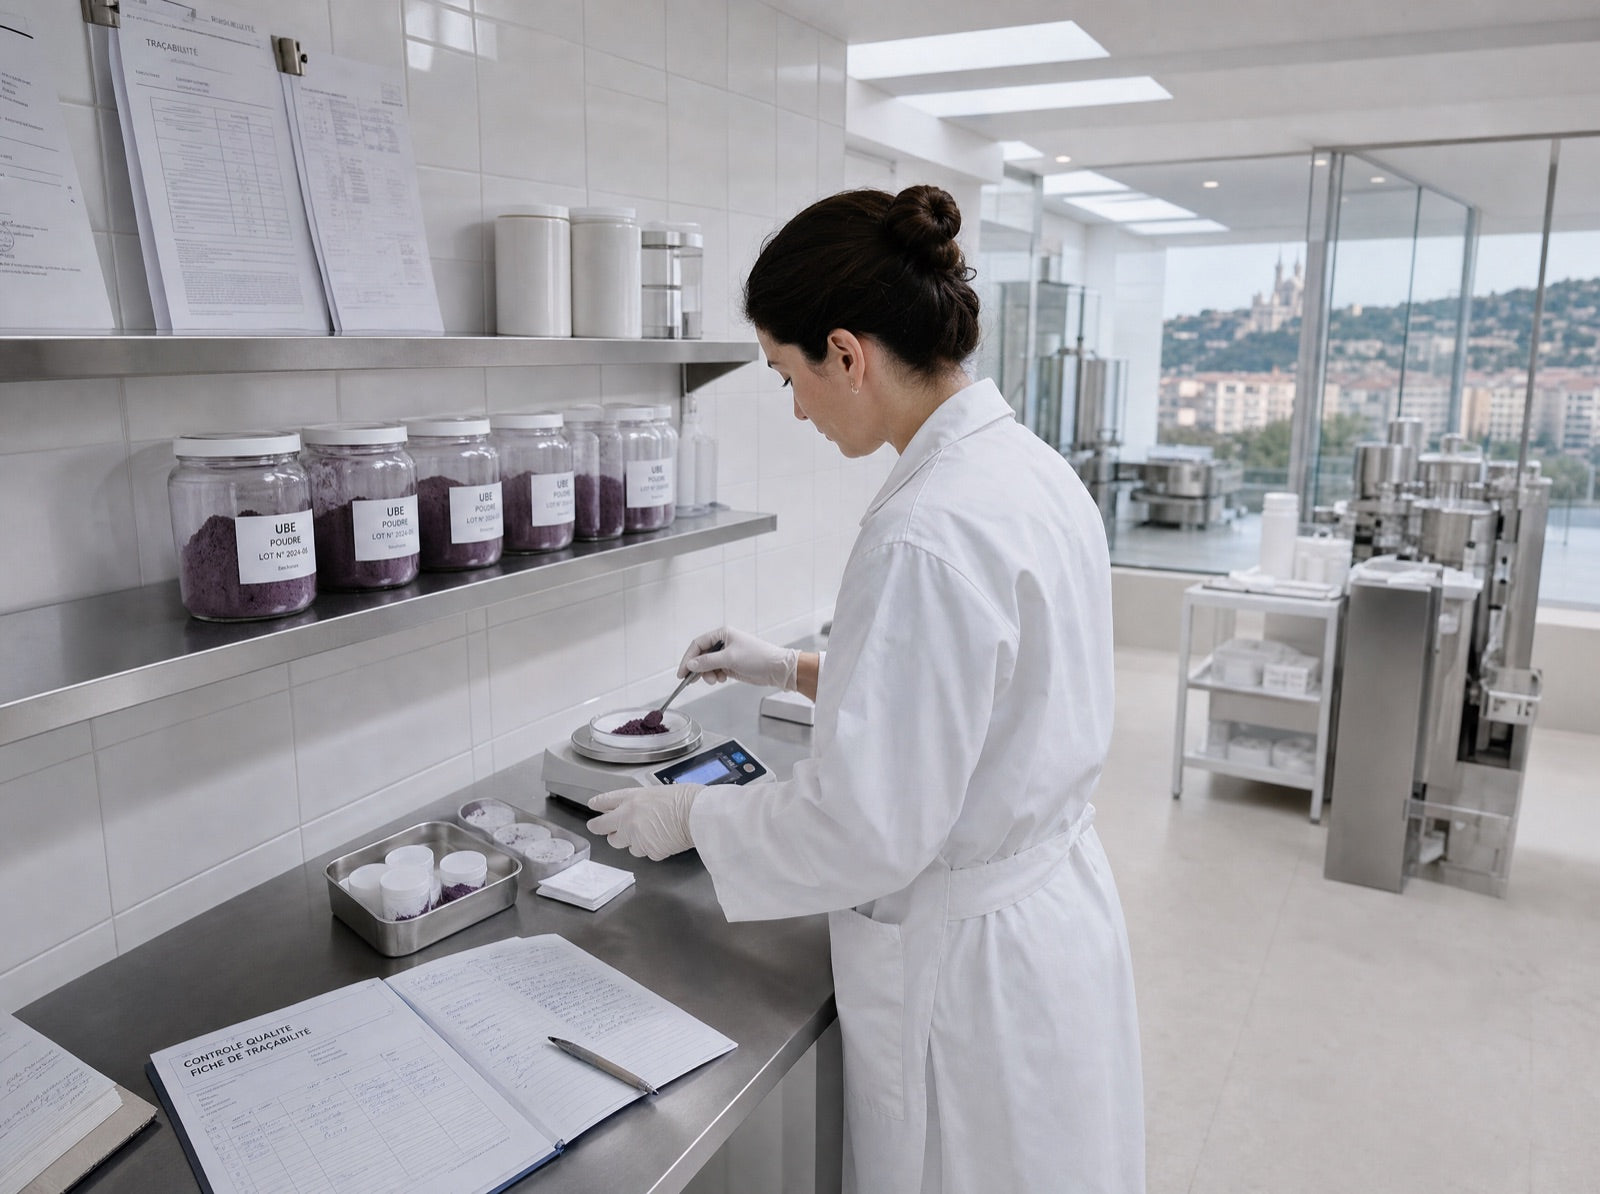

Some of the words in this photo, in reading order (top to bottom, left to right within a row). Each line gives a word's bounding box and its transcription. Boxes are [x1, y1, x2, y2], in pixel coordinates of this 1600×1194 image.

[556, 479, 569, 489] UBE
[479, 491, 493, 502] UBE
[387, 506, 404, 517] UBE
[275, 522, 296, 534] UBE
[382, 518, 408, 528] POUDRE
[270, 536, 301, 547] POUDRE
[372, 532, 385, 541] LOT
[259, 552, 274, 561] LOT
[183, 1041, 244, 1068] CONTROLE
[190, 1059, 226, 1077] FICHE
[227, 1052, 244, 1064] DE
[245, 1026, 312, 1057] TRAÇABILITÉ
